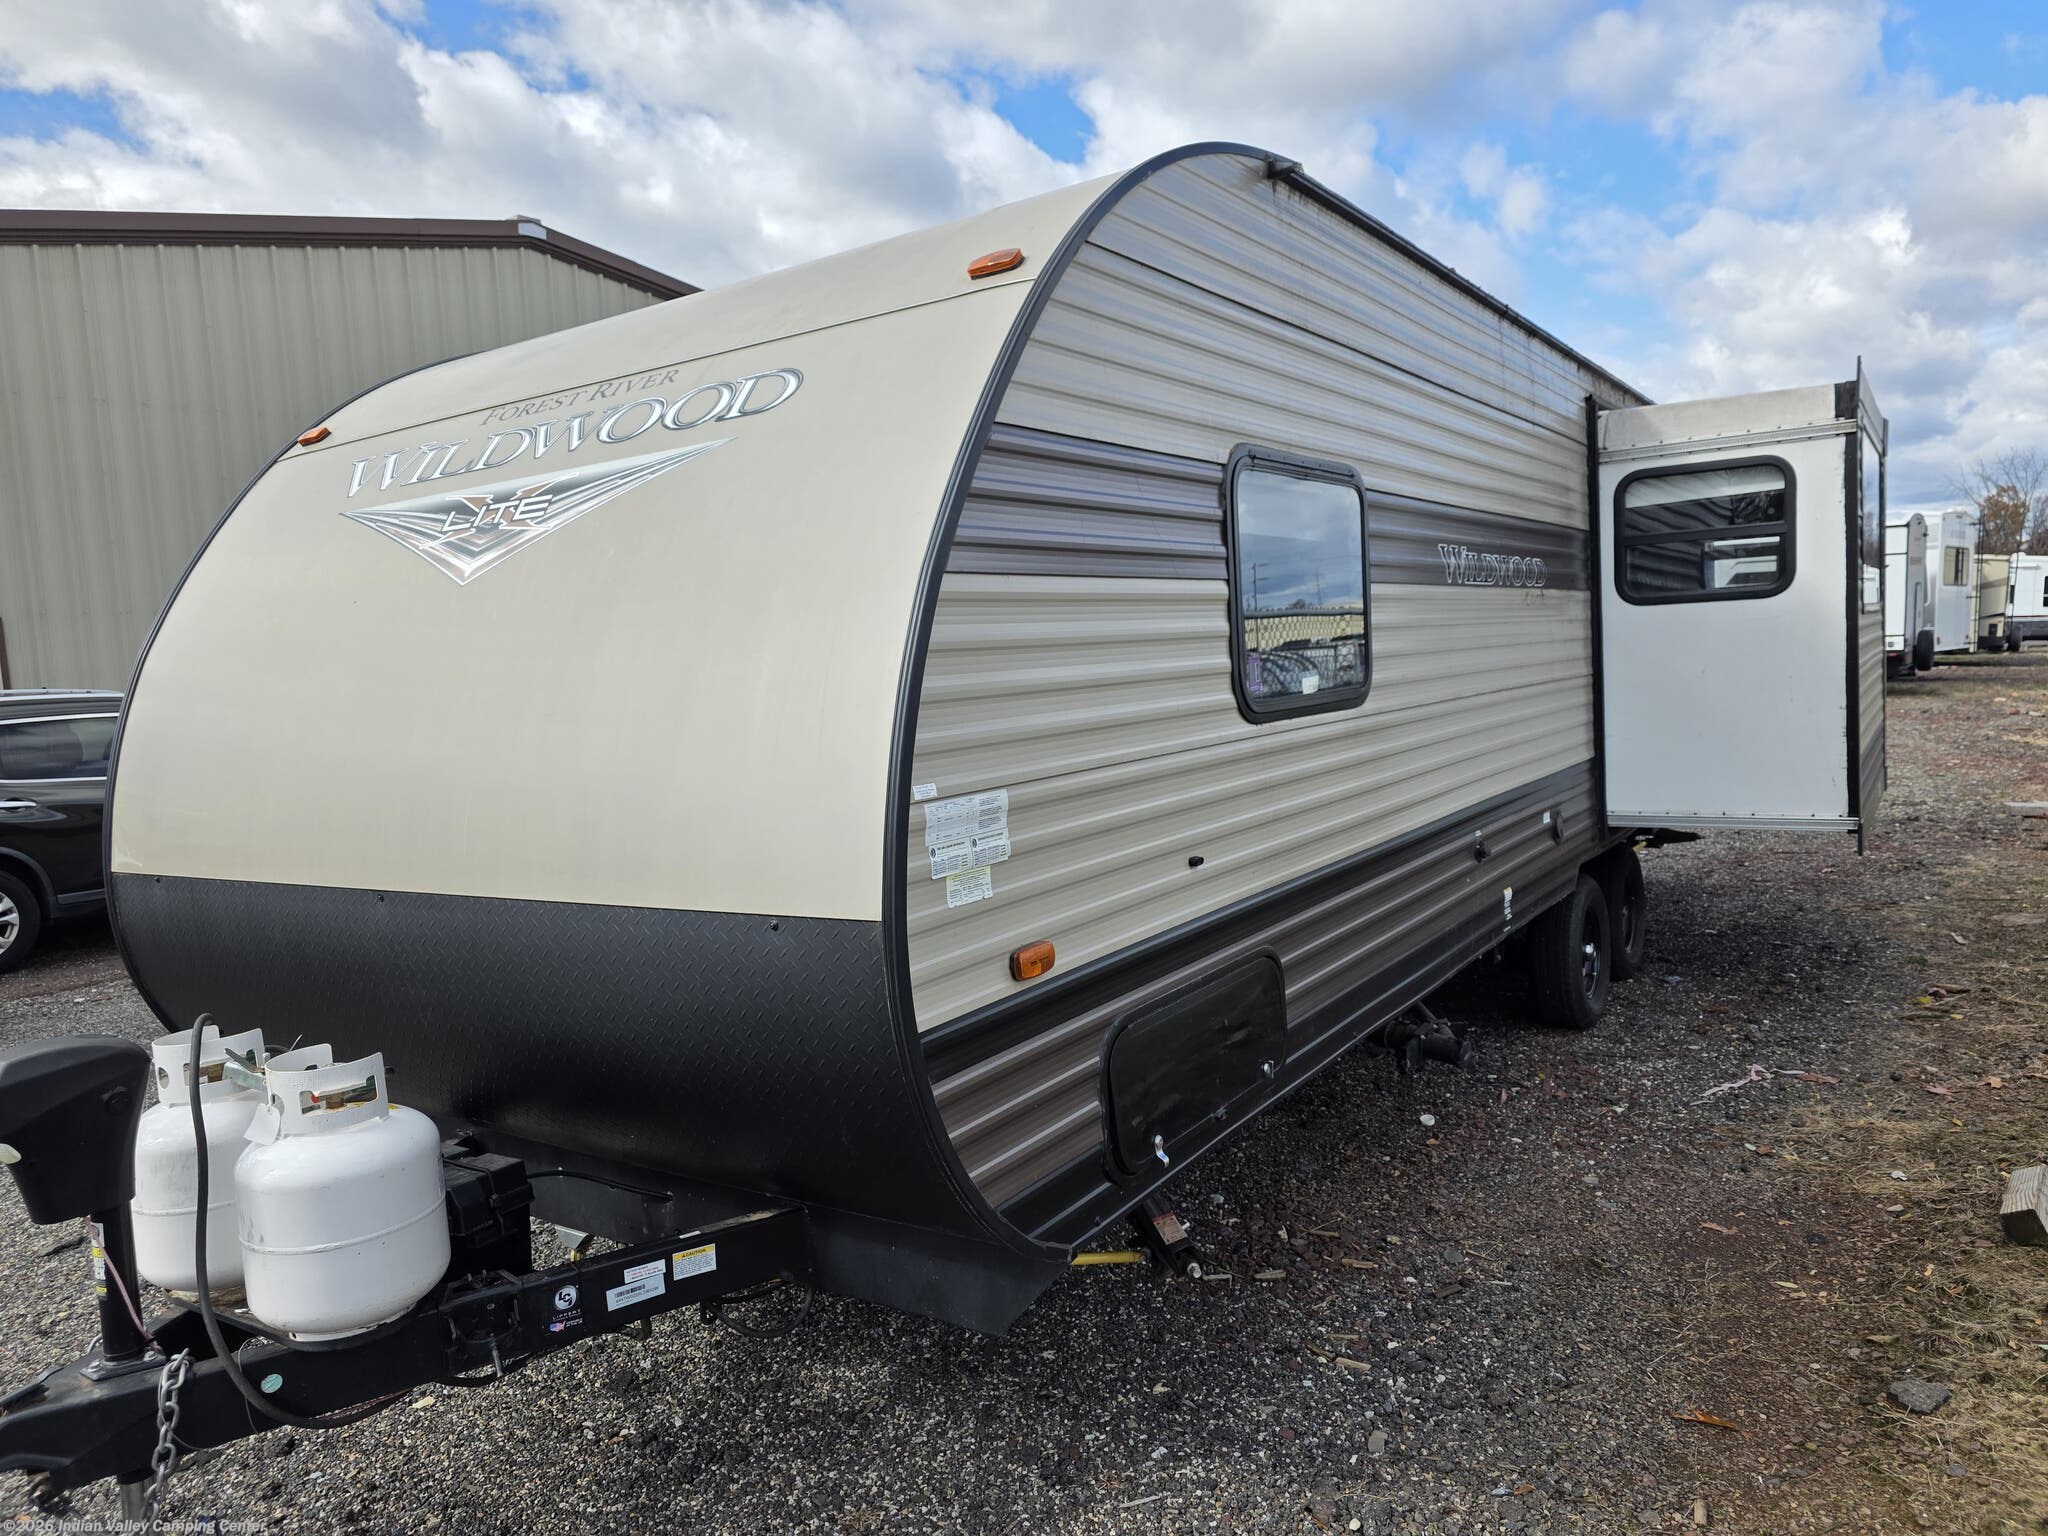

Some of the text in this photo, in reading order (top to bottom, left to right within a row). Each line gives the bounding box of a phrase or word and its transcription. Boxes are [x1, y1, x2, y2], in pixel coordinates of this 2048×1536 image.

[482, 369, 680, 426] FOREST RIVER
[347, 367, 804, 498] WILDWOOD
[1438, 544, 1548, 587] WILDWOOD
